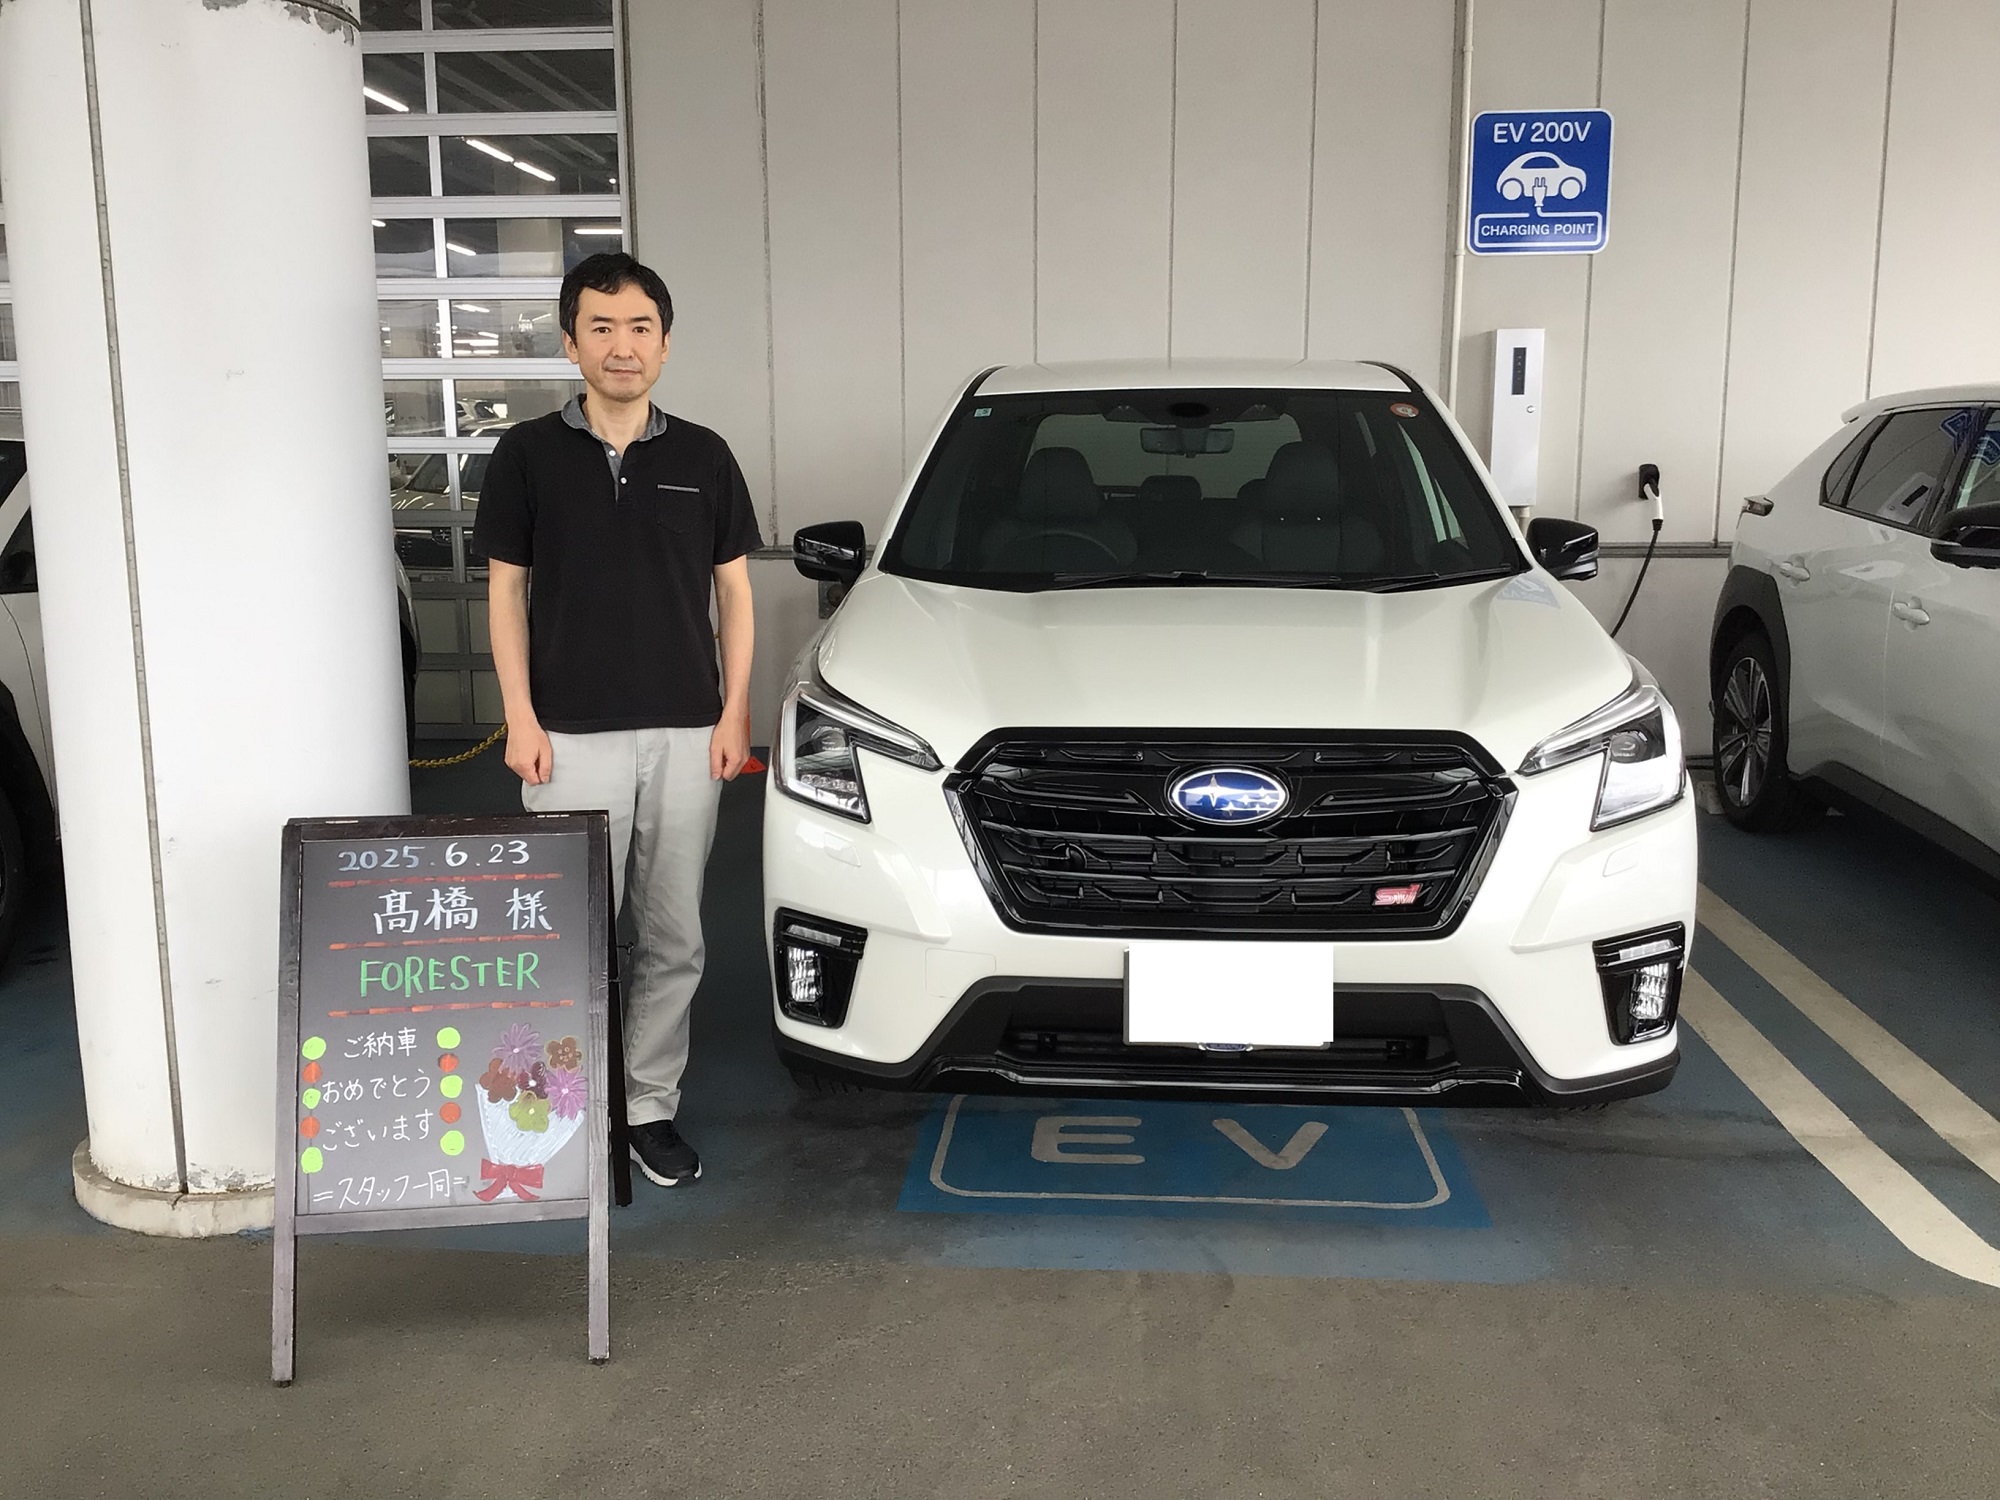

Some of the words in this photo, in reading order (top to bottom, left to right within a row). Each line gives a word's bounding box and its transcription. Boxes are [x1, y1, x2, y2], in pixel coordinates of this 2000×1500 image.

[1493, 122, 1526, 143] EV
[1530, 121, 1592, 142] 200V
[1481, 224, 1550, 236] CHARGING
[1554, 223, 1595, 235] POINT
[505, 887, 553, 931] 様
[360, 952, 541, 997] FORESTER
[344, 1026, 418, 1058] ご納車
[322, 1068, 432, 1104] おめでとう
[322, 1108, 434, 1150] ございます
